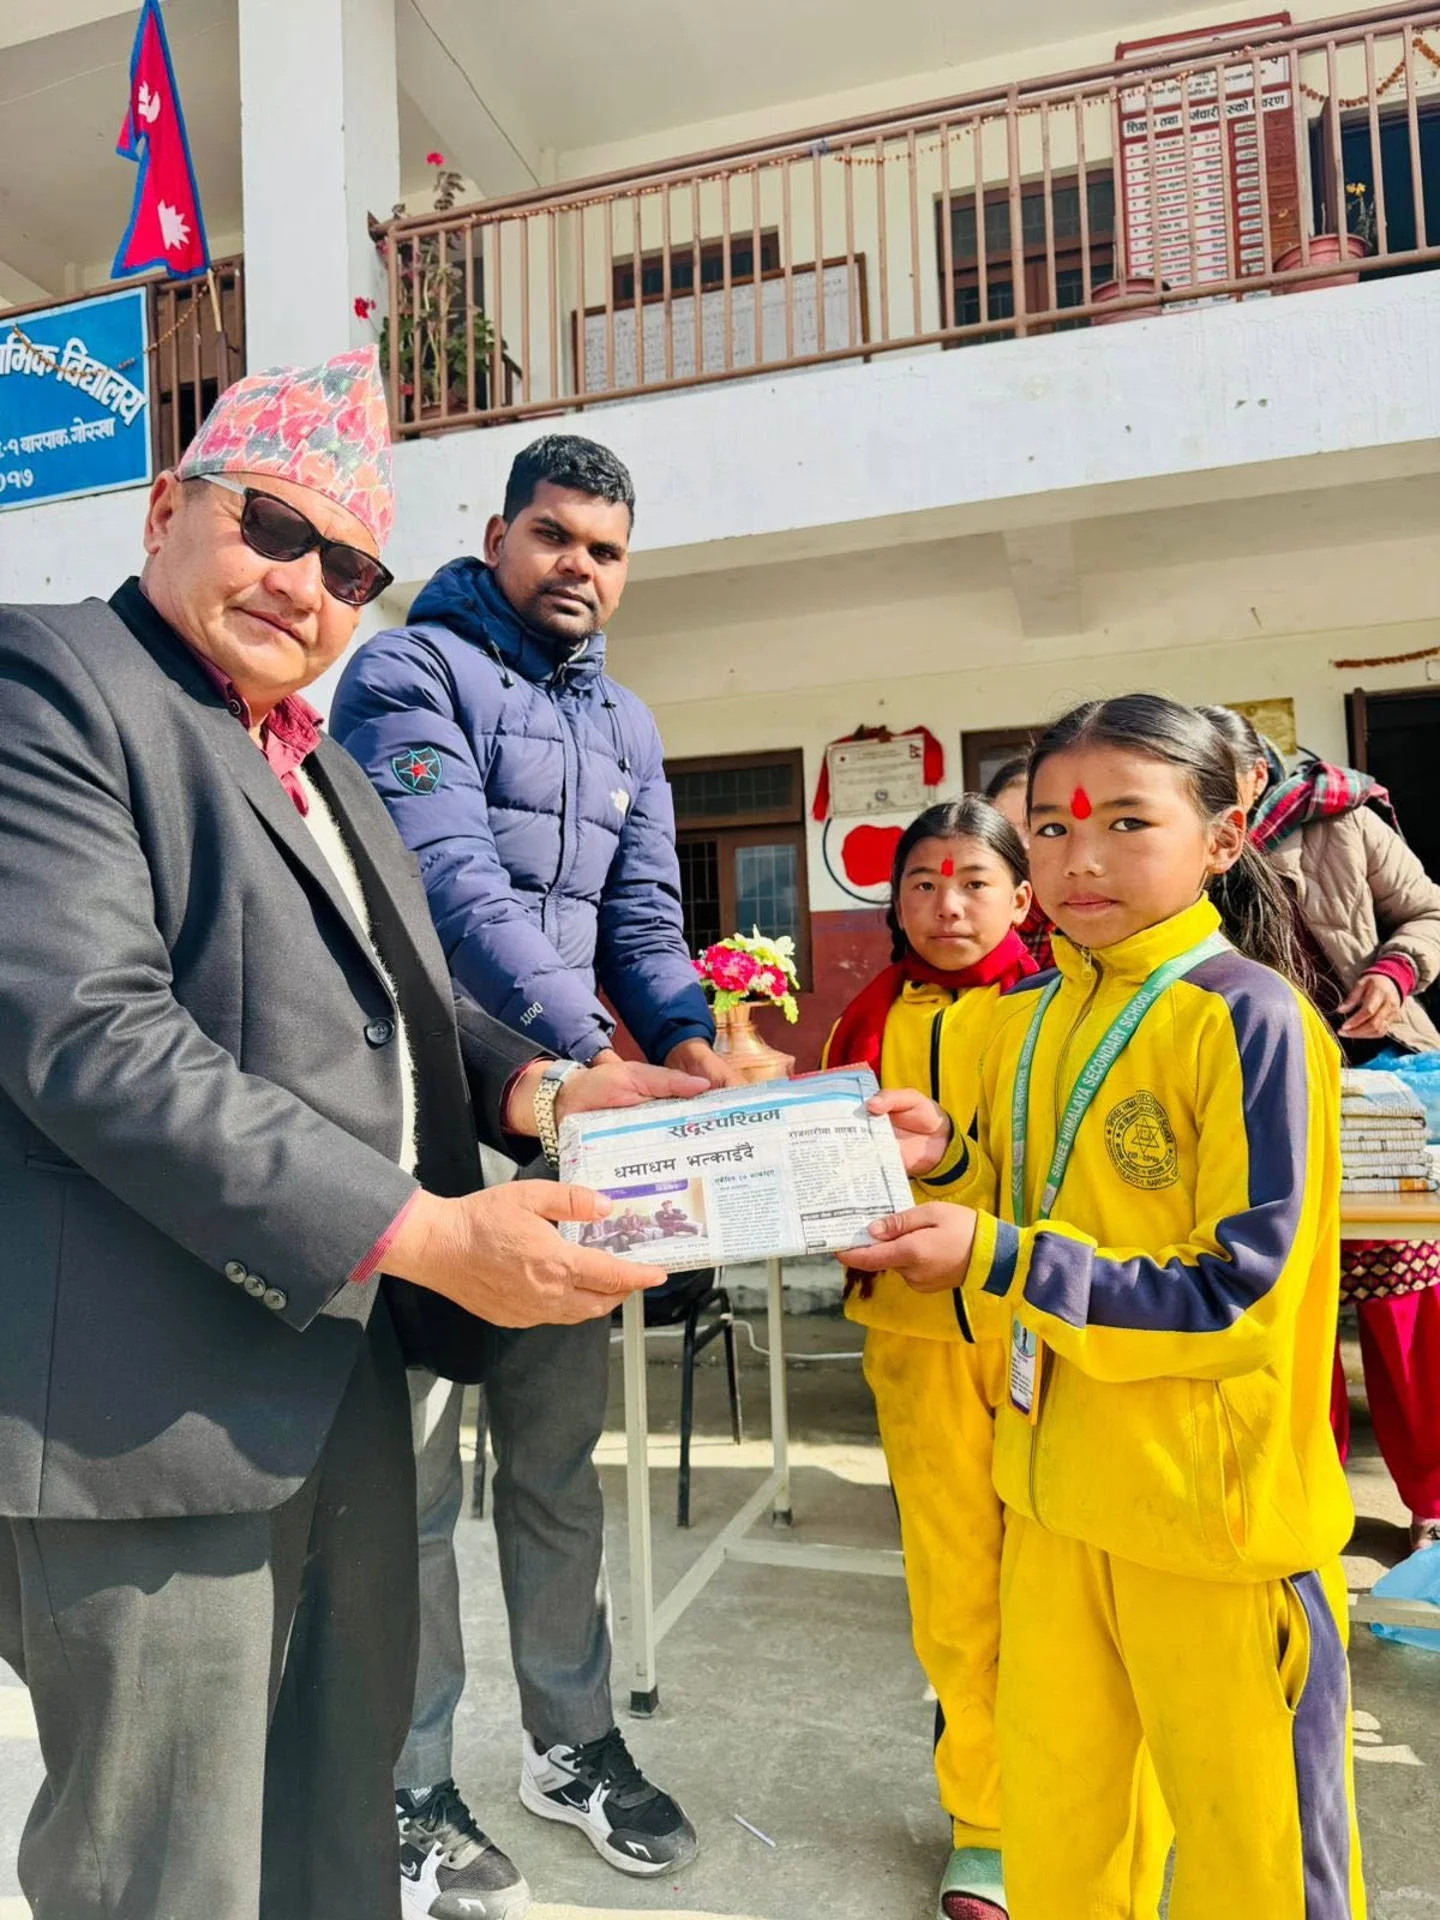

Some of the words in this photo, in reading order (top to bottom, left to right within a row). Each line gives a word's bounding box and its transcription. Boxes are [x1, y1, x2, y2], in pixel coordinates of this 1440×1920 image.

[56, 336, 148, 426] विद्यालय
[1050, 1141, 1074, 1178] SHREE
[1064, 1082, 1091, 1142] HIMALAYA
[1082, 1027, 1128, 1088] SECONDARY
[614, 1158, 676, 1178] धमाधम
